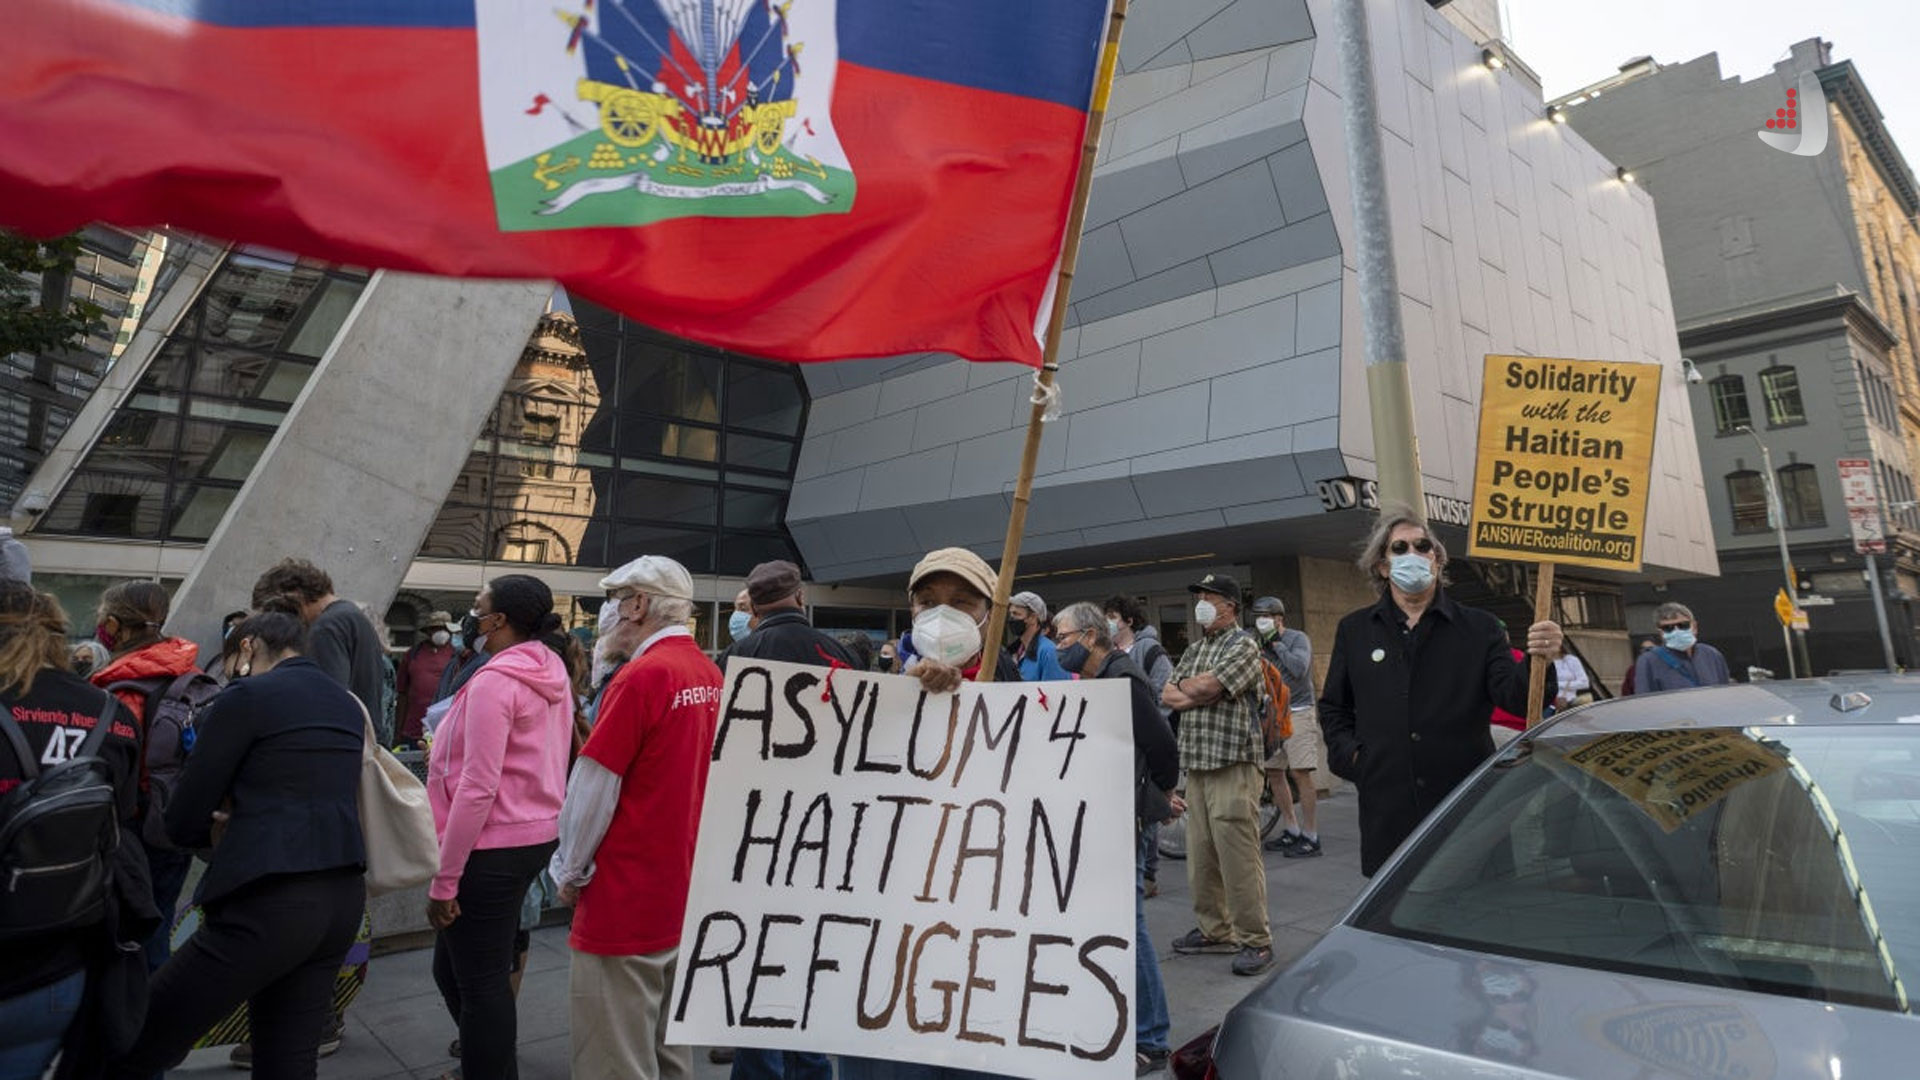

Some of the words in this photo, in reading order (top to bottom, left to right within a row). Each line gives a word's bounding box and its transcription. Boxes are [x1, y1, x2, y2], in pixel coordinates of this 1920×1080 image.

[1505, 361, 1636, 403] Solidarity
[1521, 398, 1571, 422] with
[1575, 400, 1612, 424] the
[1505, 425, 1624, 460] Haitian
[1492, 460, 1631, 498] People's
[1317, 480, 1355, 511] 90
[1427, 494, 1471, 526] NCISC
[1487, 492, 1629, 532] Struggle
[1478, 524, 1634, 560] ANSWERcoalition.org
[41, 725, 87, 765] 47
[711, 666, 1028, 793] ASYLUM
[1049, 695, 1087, 780] 4
[732, 789, 1086, 916] HAITIAN
[673, 911, 1129, 1062] REFUGEES
